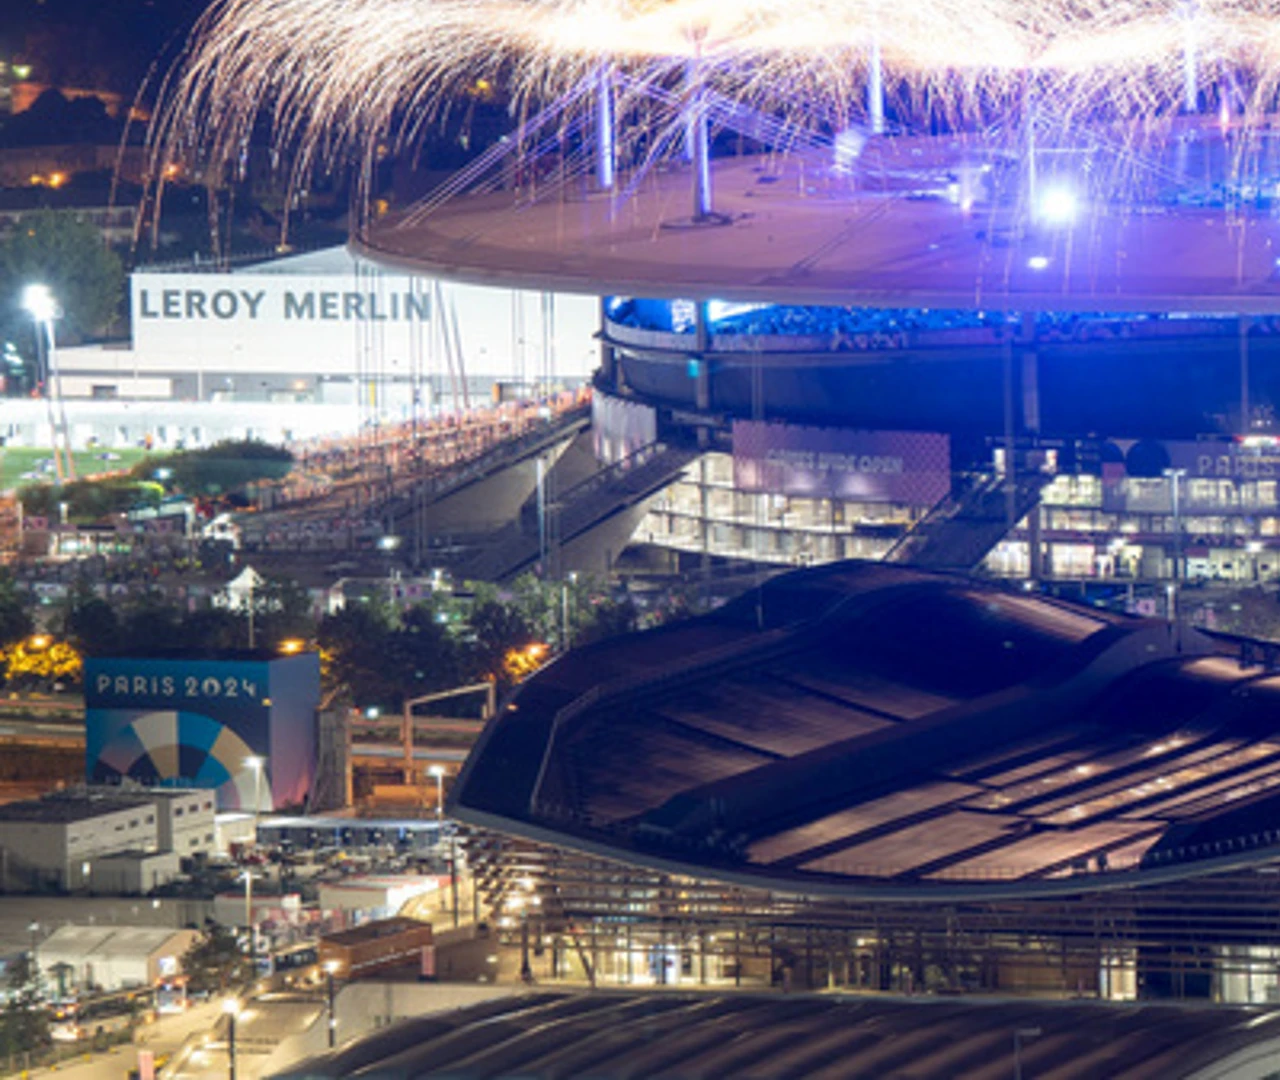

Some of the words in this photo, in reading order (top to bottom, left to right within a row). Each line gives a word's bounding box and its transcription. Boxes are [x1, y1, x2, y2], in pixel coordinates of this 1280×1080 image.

[140, 289, 266, 319] LEROY
[284, 291, 431, 321] MERLIN
[97, 674, 176, 696] PARIS
[184, 676, 257, 697] 2024
